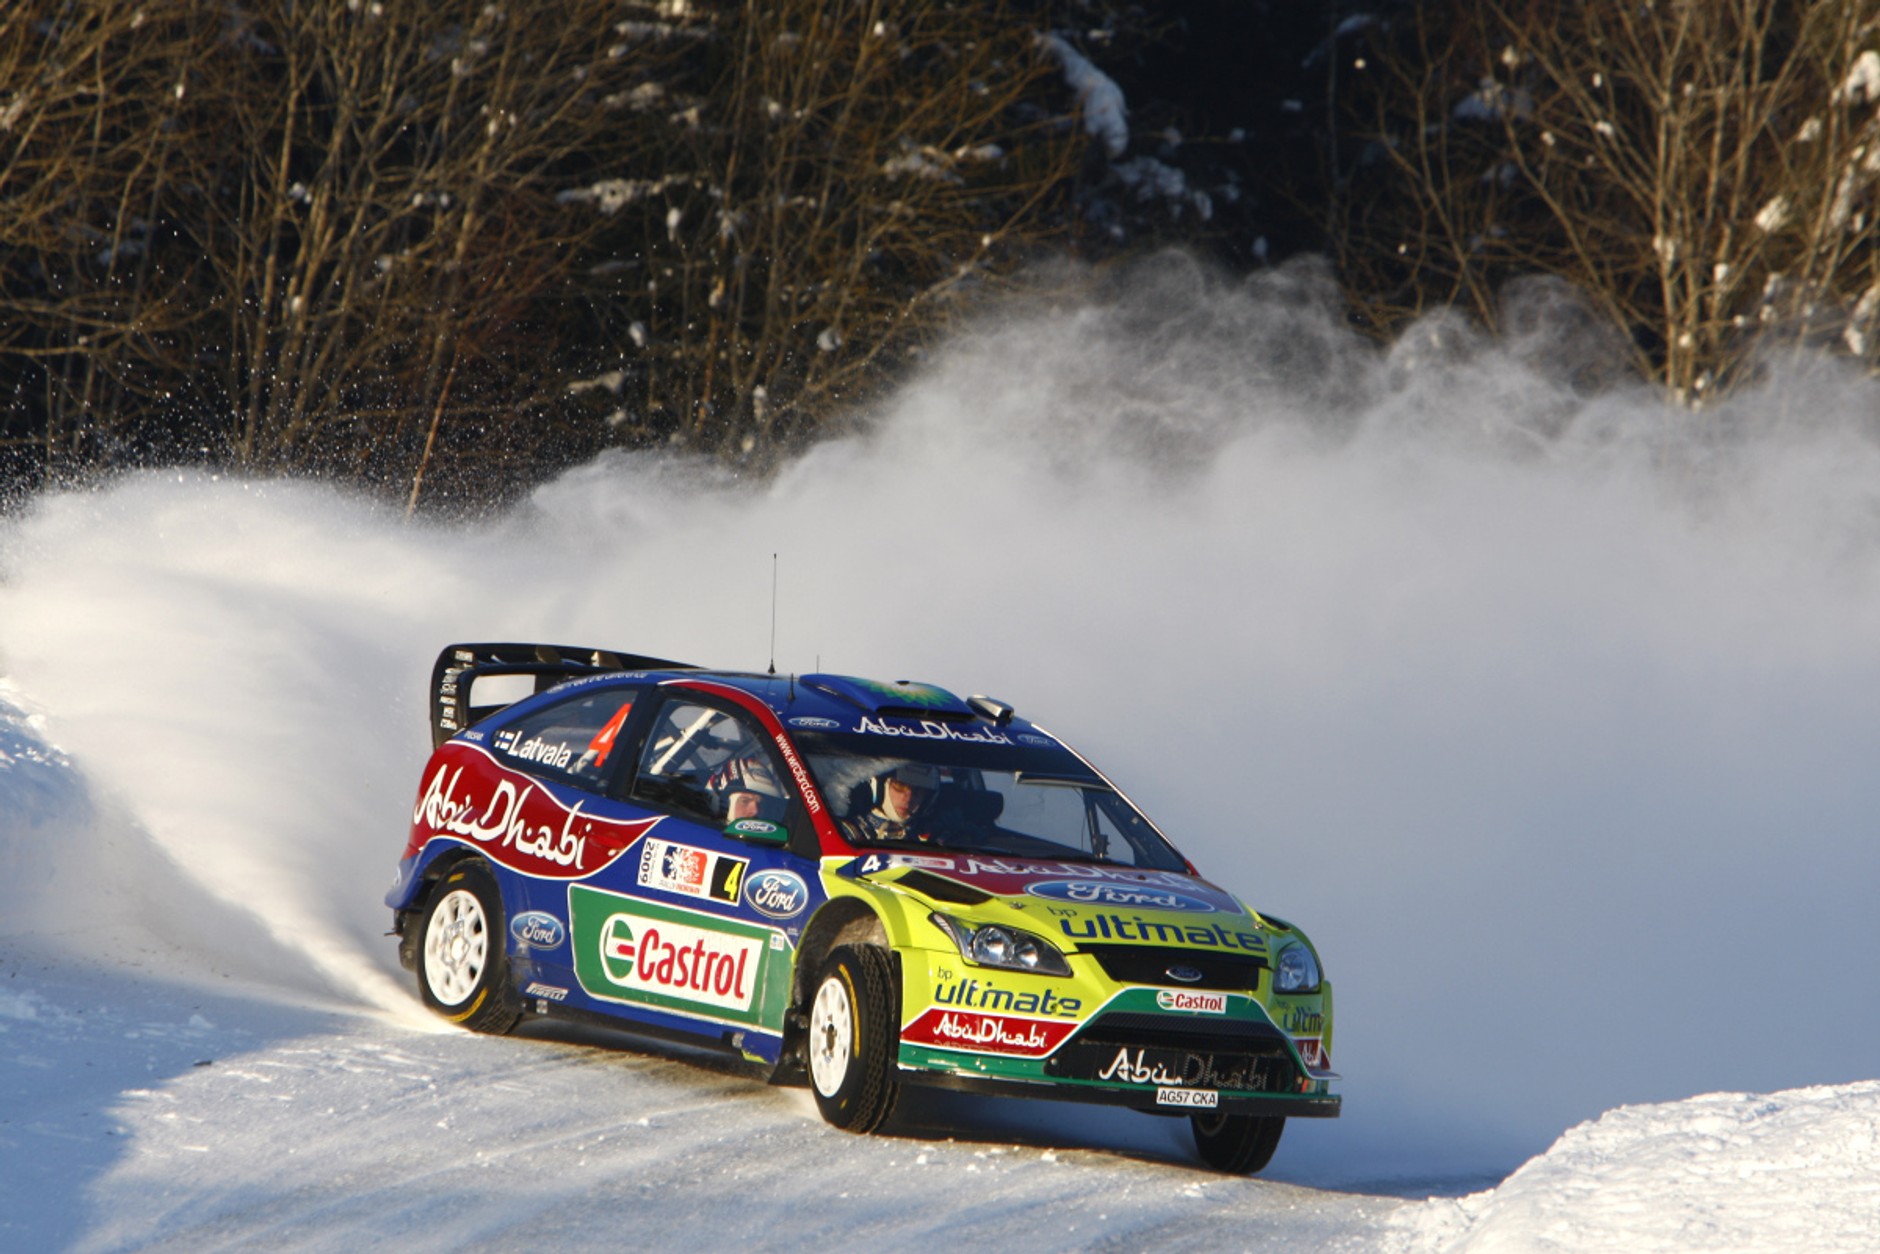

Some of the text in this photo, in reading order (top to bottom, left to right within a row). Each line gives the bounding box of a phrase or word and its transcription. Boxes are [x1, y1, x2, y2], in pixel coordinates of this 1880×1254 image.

[507, 730, 572, 769] Latvala
[640, 841, 655, 884] 2009
[861, 854, 881, 874] 4
[723, 861, 743, 900] 4
[755, 874, 798, 912] Ford
[1067, 882, 1187, 909] Ford
[1046, 905, 1078, 919] bp
[522, 915, 557, 944] Ford
[1059, 913, 1268, 952] ultimate
[637, 928, 749, 999] Castrol
[937, 965, 953, 981] bp
[934, 978, 1082, 1018] ultimate
[1175, 993, 1224, 1011] Castrol
[1158, 1090, 1217, 1105] AG57 CKA
